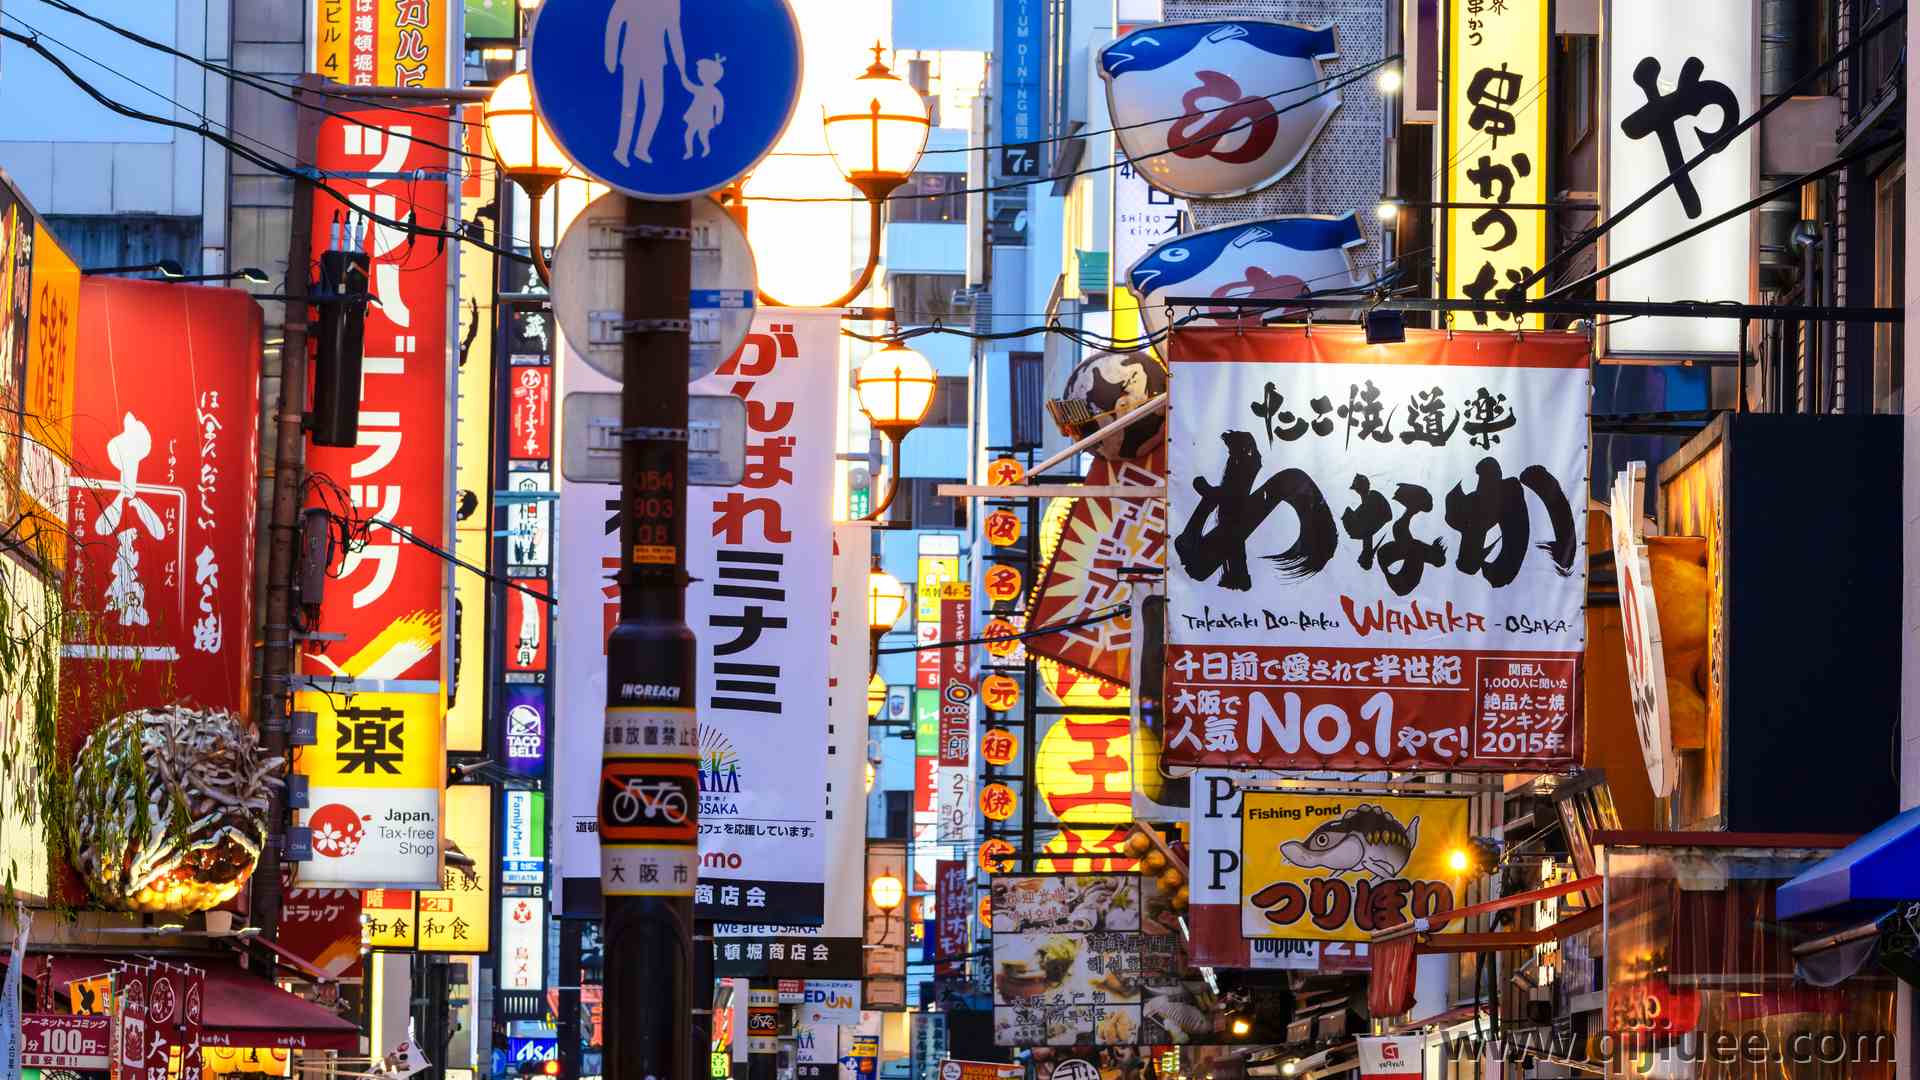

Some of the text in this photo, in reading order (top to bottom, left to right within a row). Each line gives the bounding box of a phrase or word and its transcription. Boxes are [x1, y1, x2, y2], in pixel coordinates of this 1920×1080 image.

[1620, 56, 1740, 219] や
[1007, 149, 1034, 174] 7F
[542, 355, 552, 366] 5
[1250, 380, 1517, 451] たこ焼道楽
[539, 460, 549, 471] 4
[708, 322, 800, 714] がんばれミナミ
[1174, 429, 1577, 597] わなか
[537, 567, 548, 578] 3
[537, 673, 545, 684] 2
[1173, 650, 1462, 686] 千日前で愛されて半世紀
[1508, 663, 1545, 676] 関西人
[1171, 689, 1242, 715] 大阪で
[1483, 693, 1566, 711] 絶品たこ焼
[1246, 691, 1394, 758] No.1
[1482, 712, 1569, 731] ランキング
[336, 706, 405, 775] 薬
[506, 735, 541, 747] TACO
[1168, 716, 1239, 754] 人気
[1480, 732, 1566, 754] 2015年
[508, 747, 541, 758] BELL
[384, 808, 435, 825] Japan.
[1248, 804, 1342, 821] Fishing Pond
[378, 826, 435, 840] Tax-free
[511, 795, 524, 857] FamilyMart
[399, 842, 435, 856] Shop
[698, 852, 742, 869] mo
[609, 864, 689, 885] 大阪市
[1250, 877, 1455, 933] つりぼり
[367, 917, 410, 938] 和食
[423, 917, 470, 941] 和食
